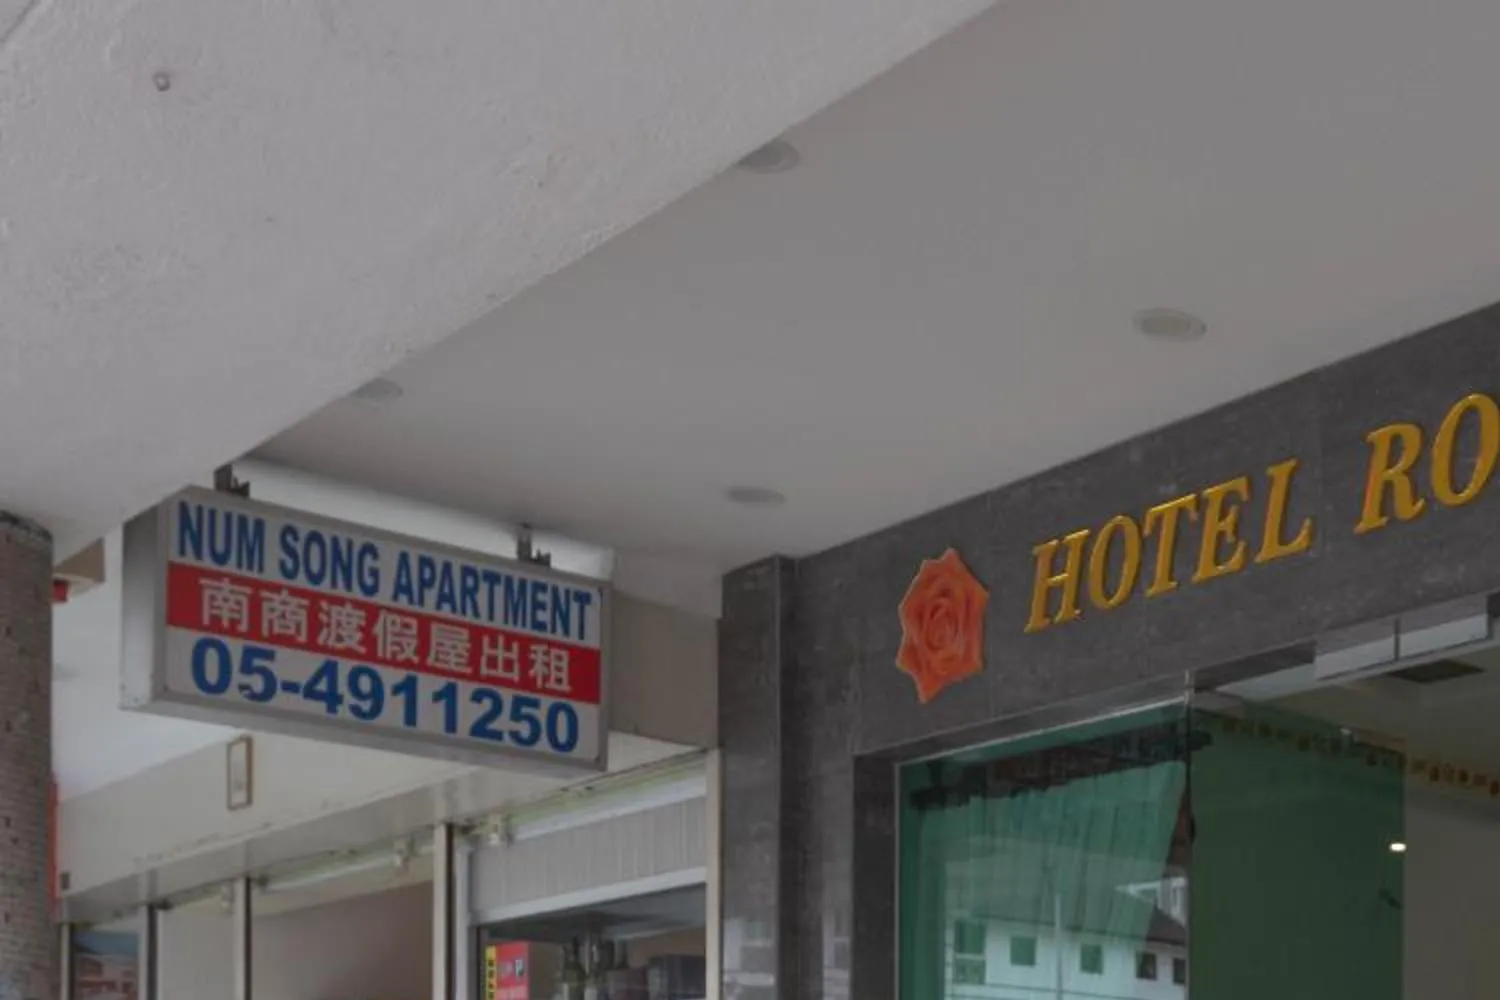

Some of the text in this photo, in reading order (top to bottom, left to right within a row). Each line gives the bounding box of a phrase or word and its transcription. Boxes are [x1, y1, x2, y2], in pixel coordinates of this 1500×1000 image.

[177, 501, 593, 640] NUM SONG APARTMENT
[1024, 459, 1313, 633] HOTEL
[190, 637, 580, 753] 05-4911250
[198, 576, 572, 693] 南商渡假屋出租
